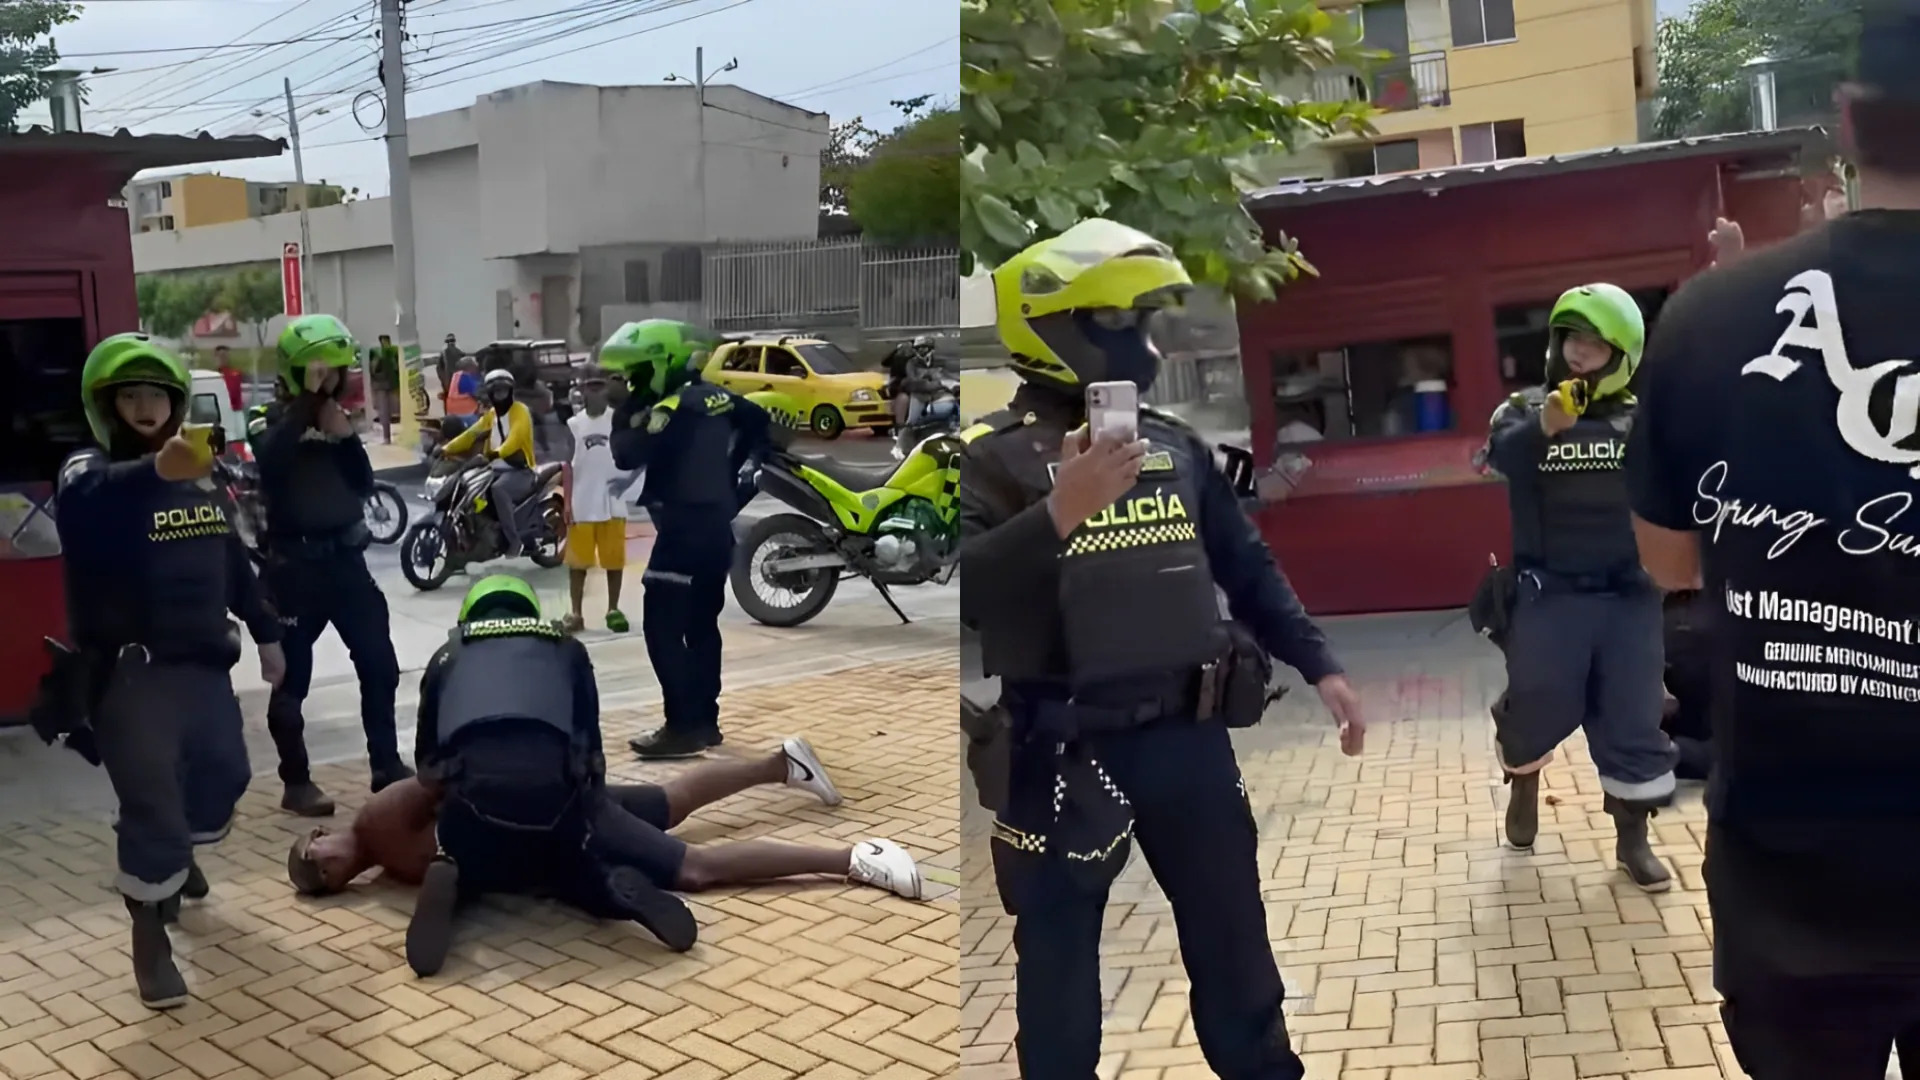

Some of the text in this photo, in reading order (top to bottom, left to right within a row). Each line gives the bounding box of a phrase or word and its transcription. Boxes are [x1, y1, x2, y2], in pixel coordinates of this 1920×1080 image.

[1085, 487, 1187, 528] OLICÍA
[1692, 461, 1920, 560] Spring Su
[1758, 590, 1915, 645] Management
